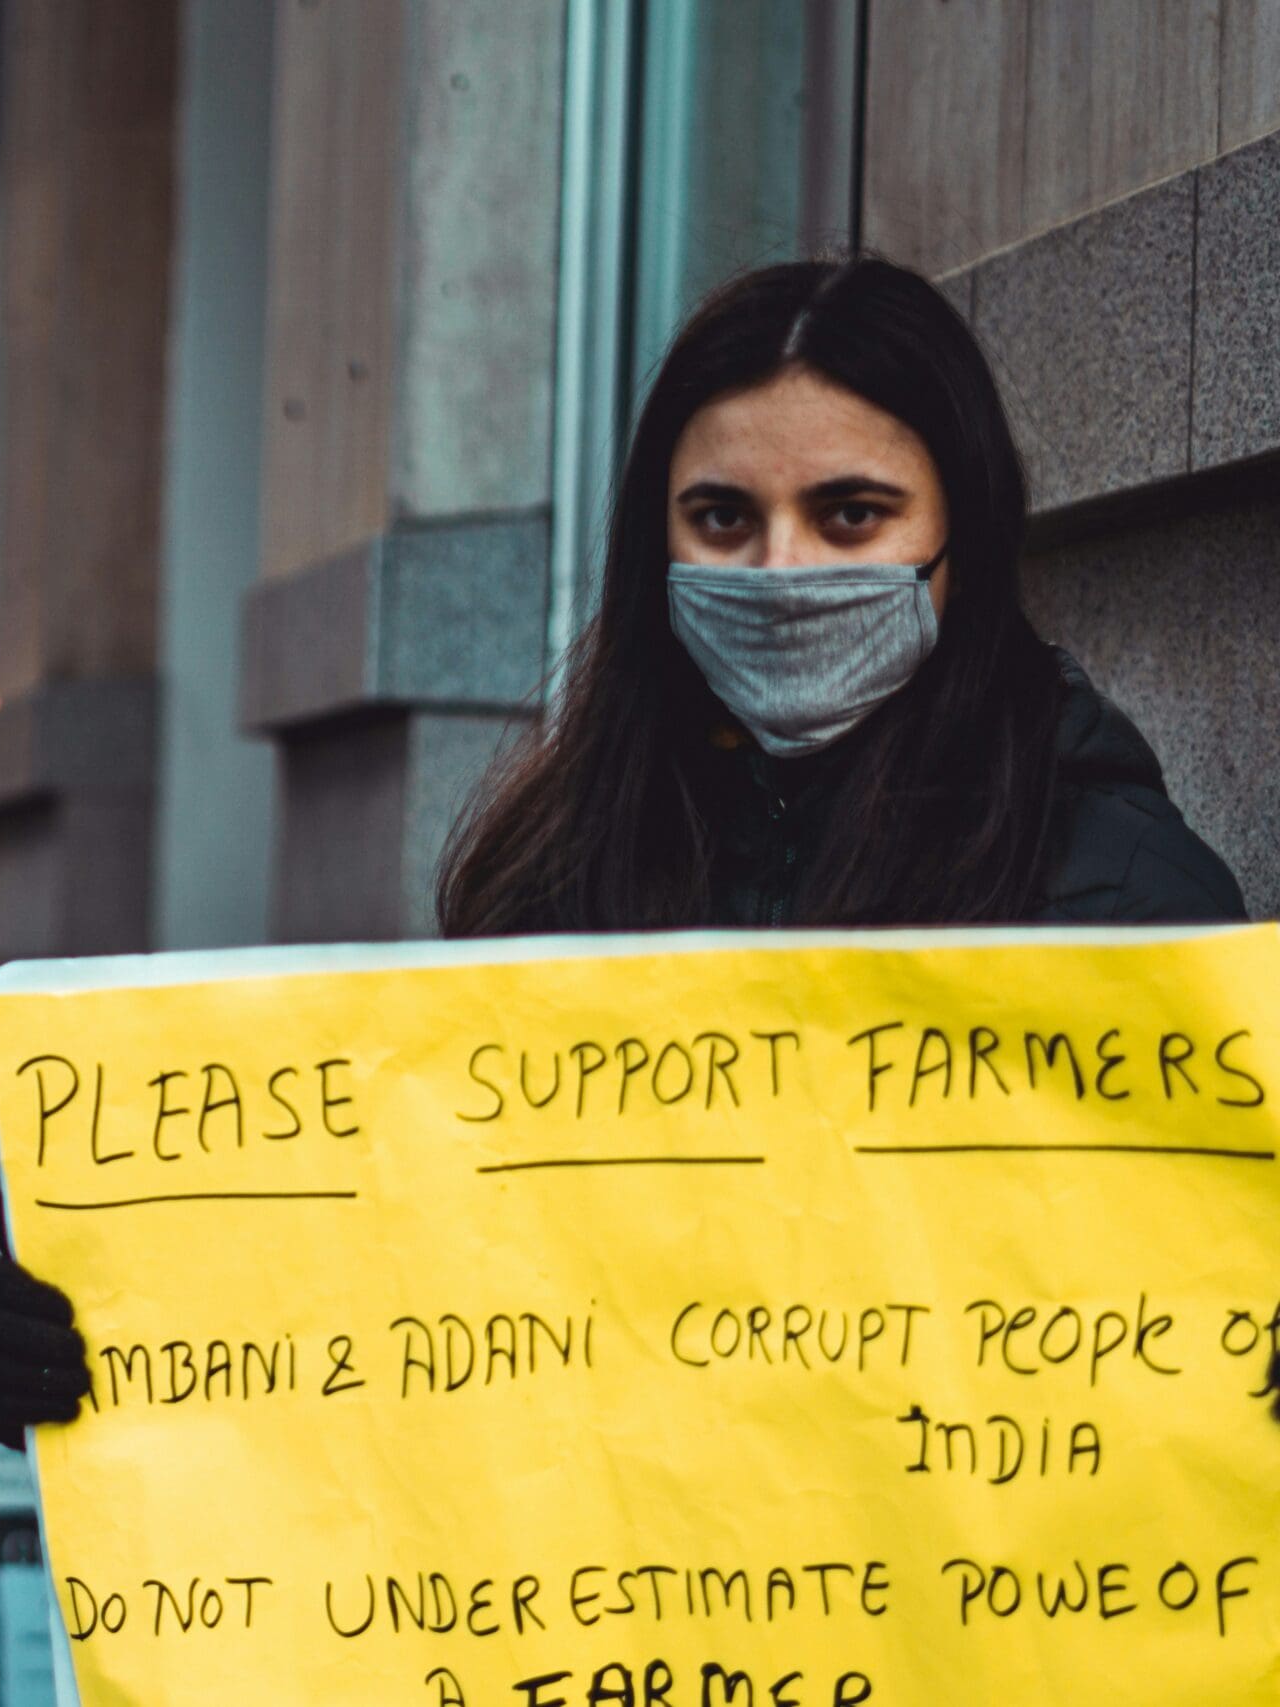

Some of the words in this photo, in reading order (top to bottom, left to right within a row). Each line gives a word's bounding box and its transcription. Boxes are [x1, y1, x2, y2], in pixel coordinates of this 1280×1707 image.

[16, 1054, 360, 1167] PLEASE
[455, 1031, 799, 1122] SUPPORT
[847, 1020, 1266, 1110] FARMERS
[670, 1300, 931, 1372] CORRUPT
[142, 1576, 273, 1636] NOT
